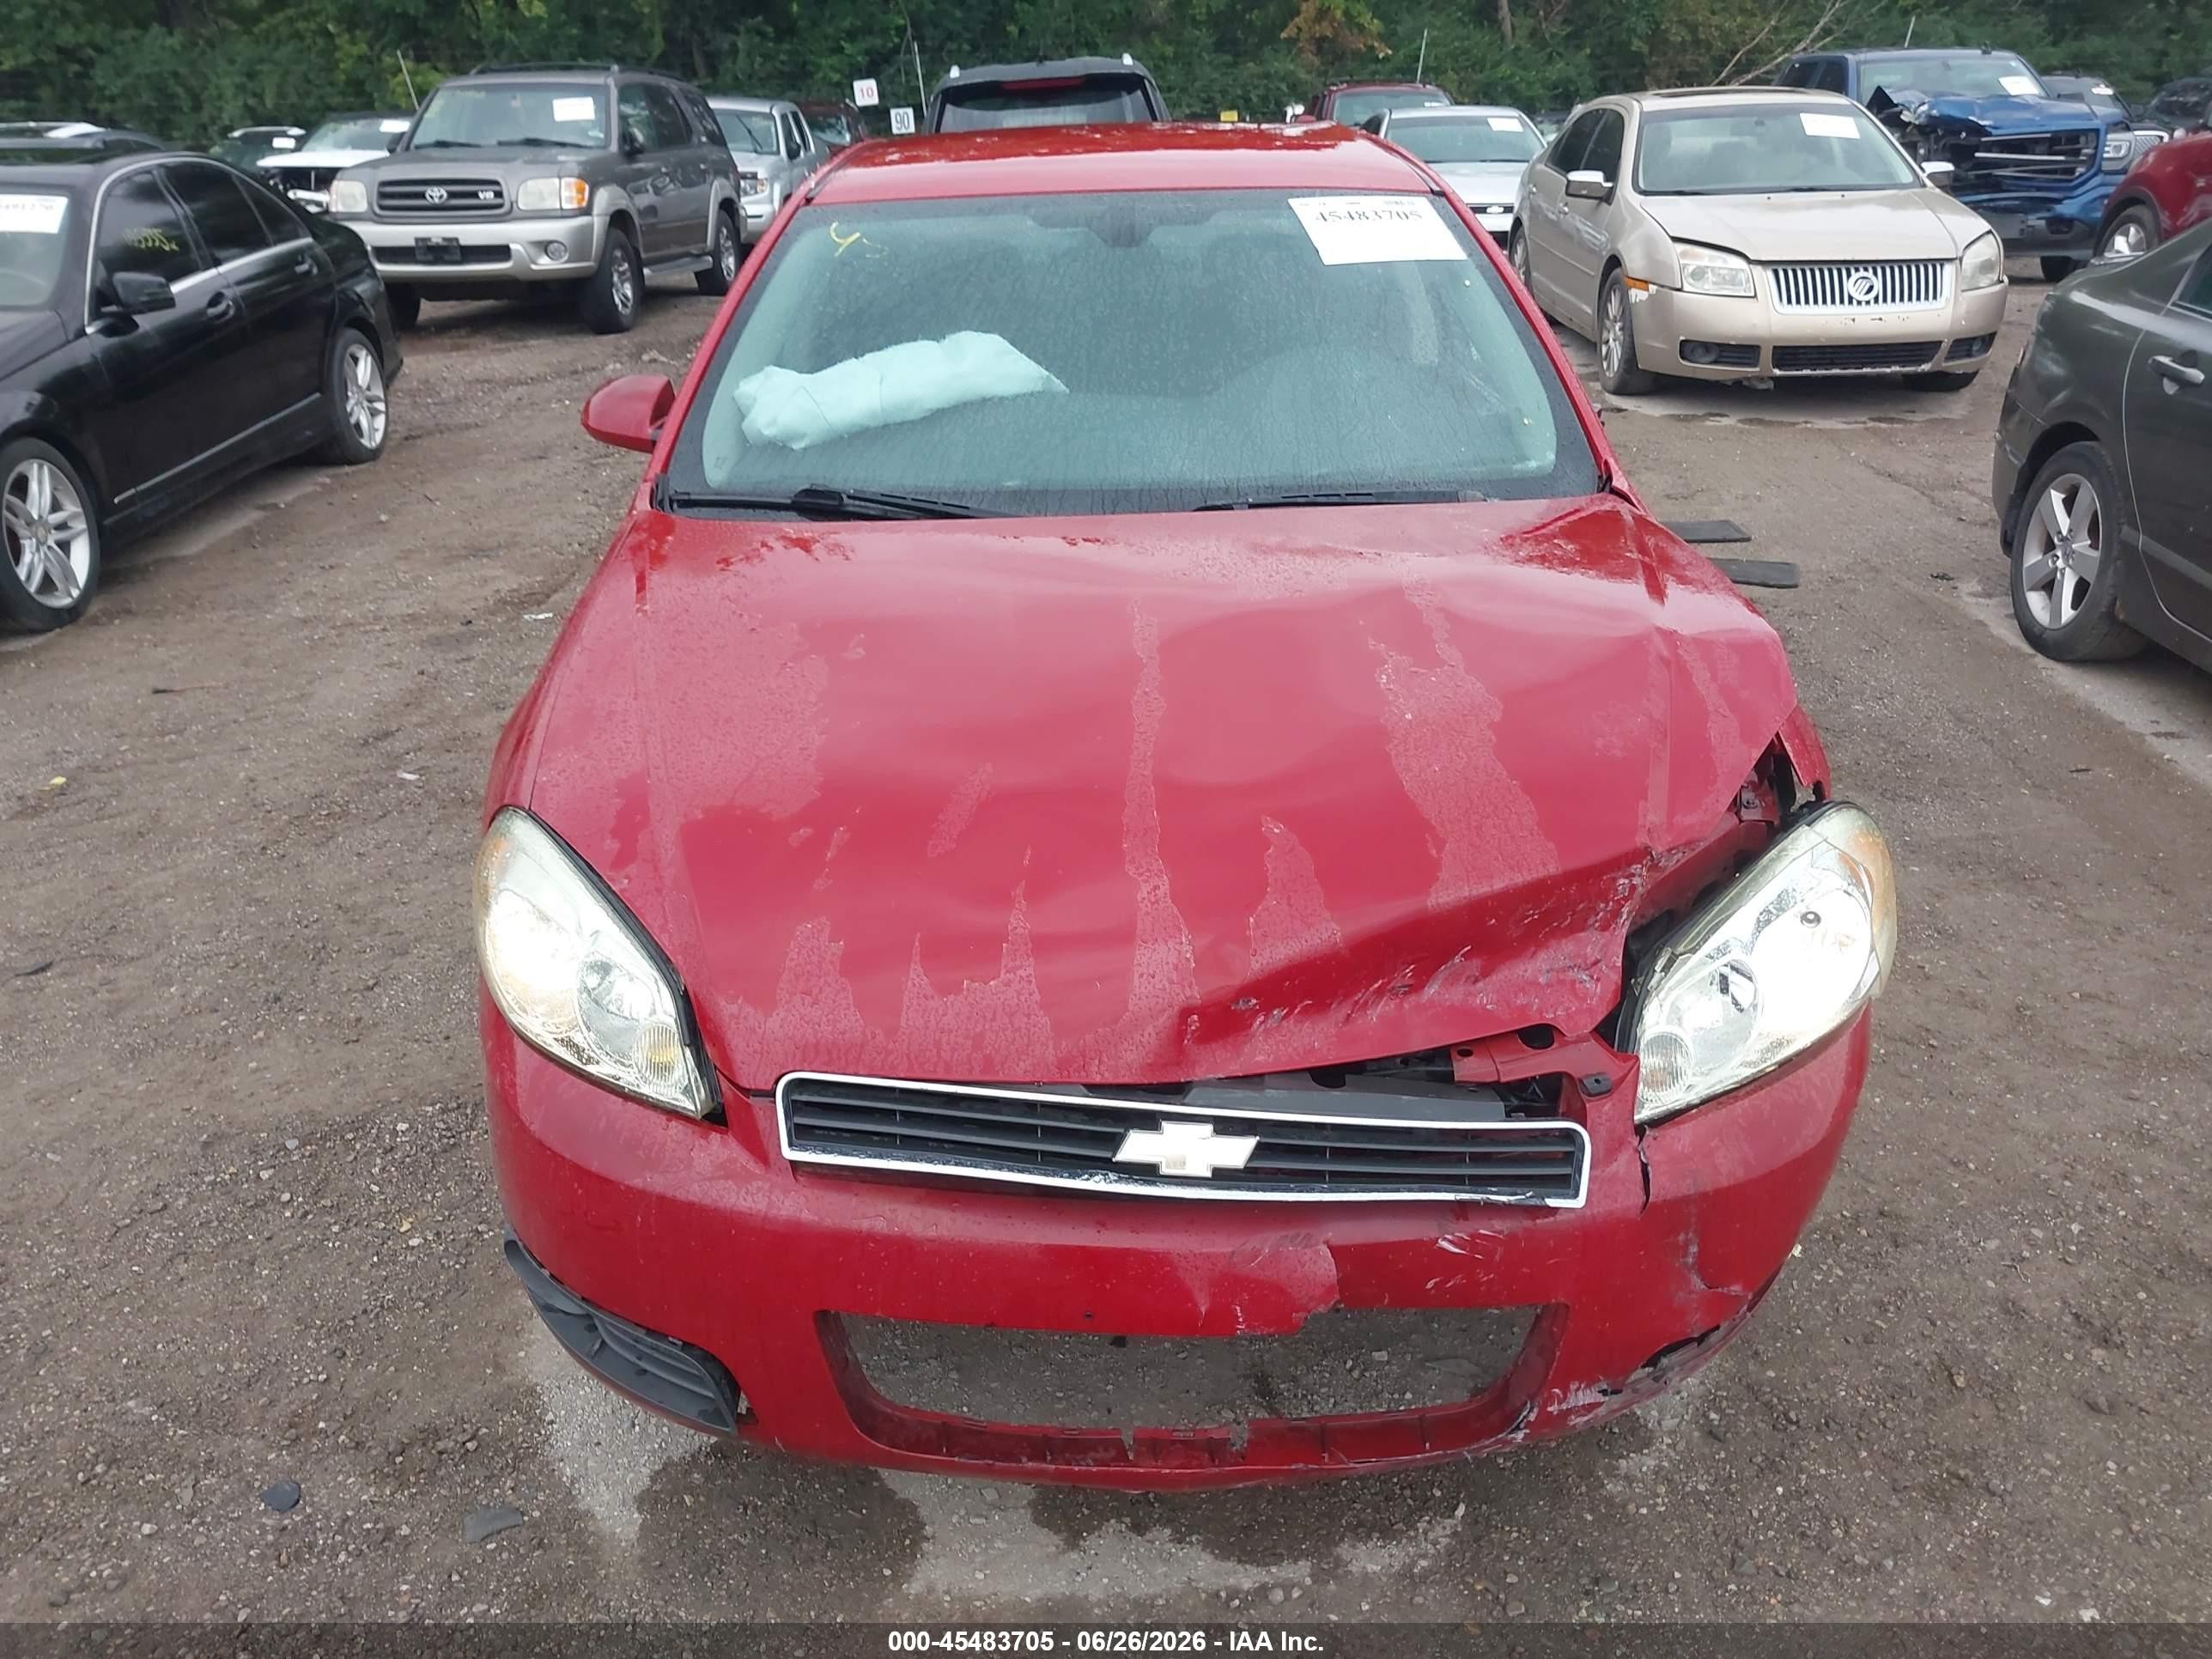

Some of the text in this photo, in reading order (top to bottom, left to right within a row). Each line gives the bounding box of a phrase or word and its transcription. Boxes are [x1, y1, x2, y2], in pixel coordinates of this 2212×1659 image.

[860, 86, 874, 99] 10
[895, 112, 910, 131] 90
[1316, 210, 1423, 222] 45483705
